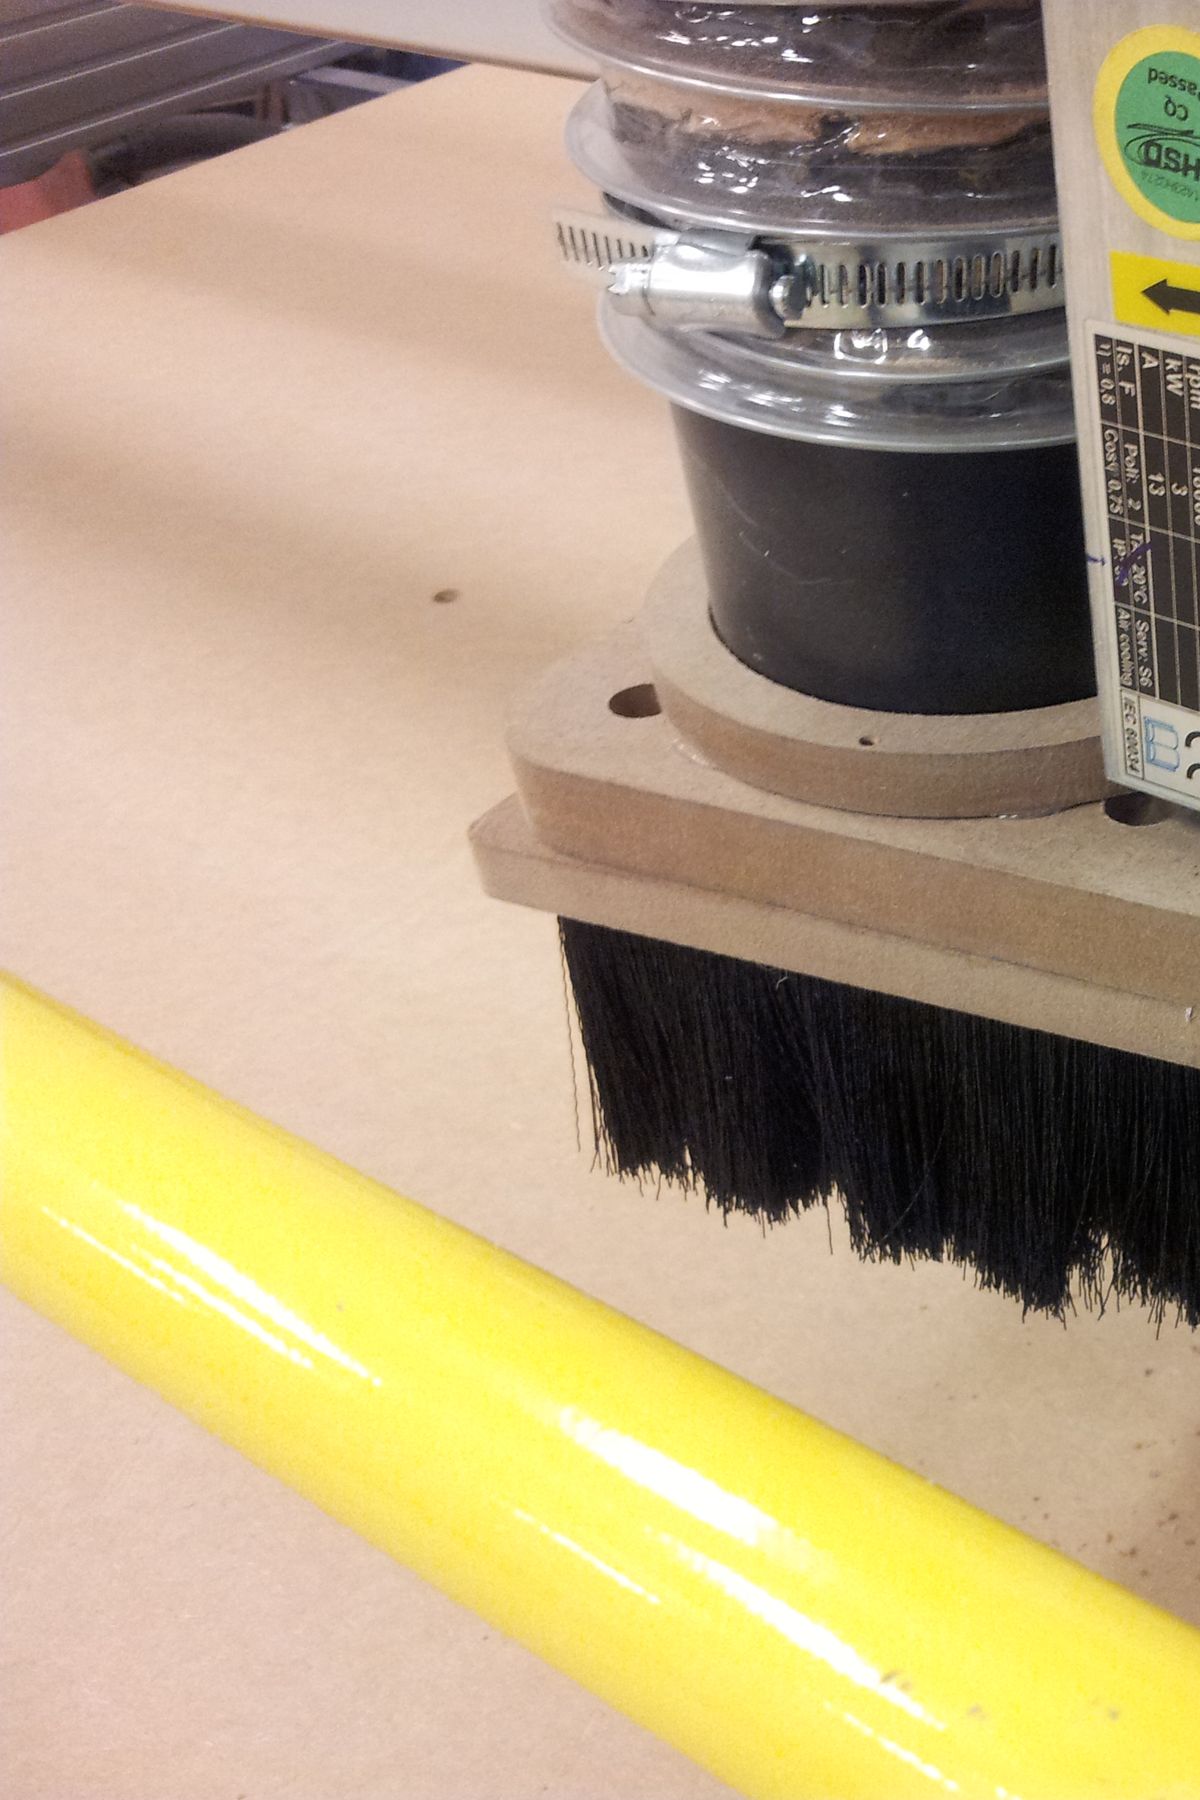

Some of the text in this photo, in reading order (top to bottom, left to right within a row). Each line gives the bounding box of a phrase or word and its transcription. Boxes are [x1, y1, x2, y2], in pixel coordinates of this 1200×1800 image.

[1164, 95, 1189, 121] CQ
[1141, 352, 1165, 496] A 13
[1164, 358, 1188, 496] kW 3
[1117, 380, 1135, 396] F
[1126, 498, 1141, 510] 2
[1138, 665, 1152, 687] S6
[1118, 633, 1134, 686] cooling
